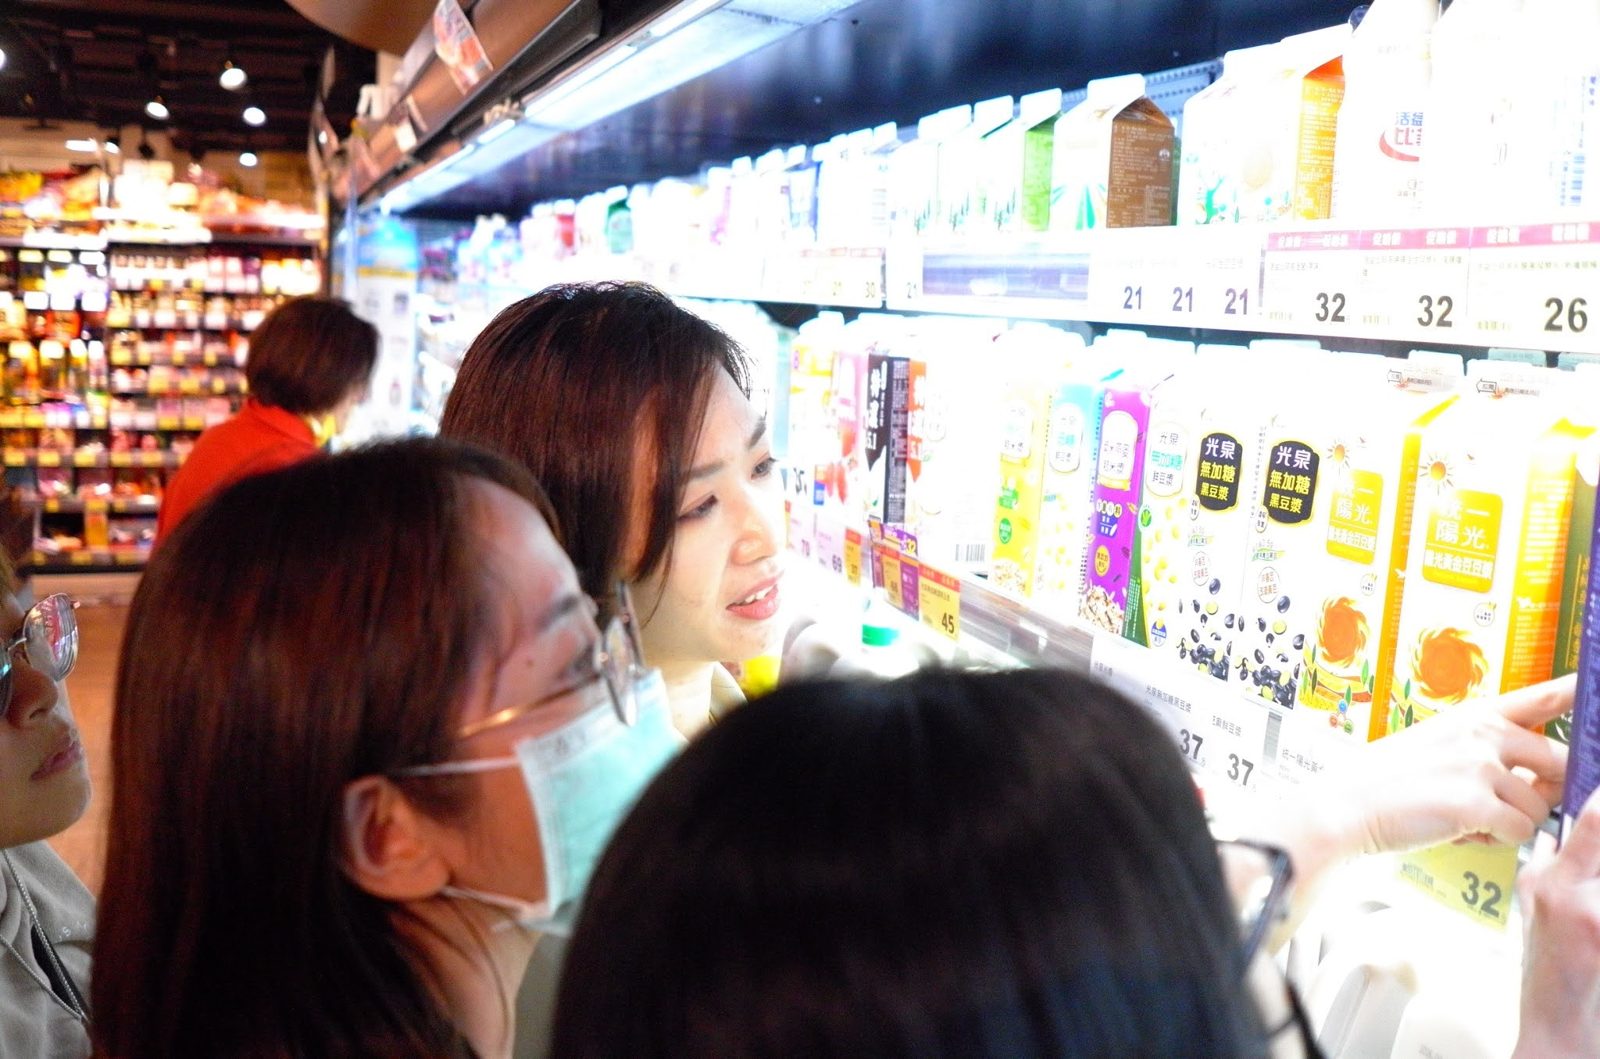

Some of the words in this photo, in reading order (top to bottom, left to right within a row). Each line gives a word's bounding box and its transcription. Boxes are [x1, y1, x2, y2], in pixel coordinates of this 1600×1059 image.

[1123, 286, 1142, 310] 21
[1172, 286, 1193, 313] 21
[1224, 288, 1248, 315] 21
[1315, 292, 1346, 323] 32
[1417, 294, 1453, 328] 32
[1544, 297, 1588, 333] 26
[1205, 437, 1236, 460] 光泉
[1275, 446, 1311, 470] 光泉
[1200, 460, 1236, 483] 無加糖
[1269, 469, 1311, 495] 無加糖
[1200, 482, 1230, 501] 黑豆漿
[1269, 493, 1304, 514] 黑豆漿
[1435, 519, 1489, 549] 陽光
[941, 612, 955, 634] 45
[1179, 728, 1204, 760] 37
[1227, 753, 1254, 786] 37
[1461, 871, 1502, 918] 32
